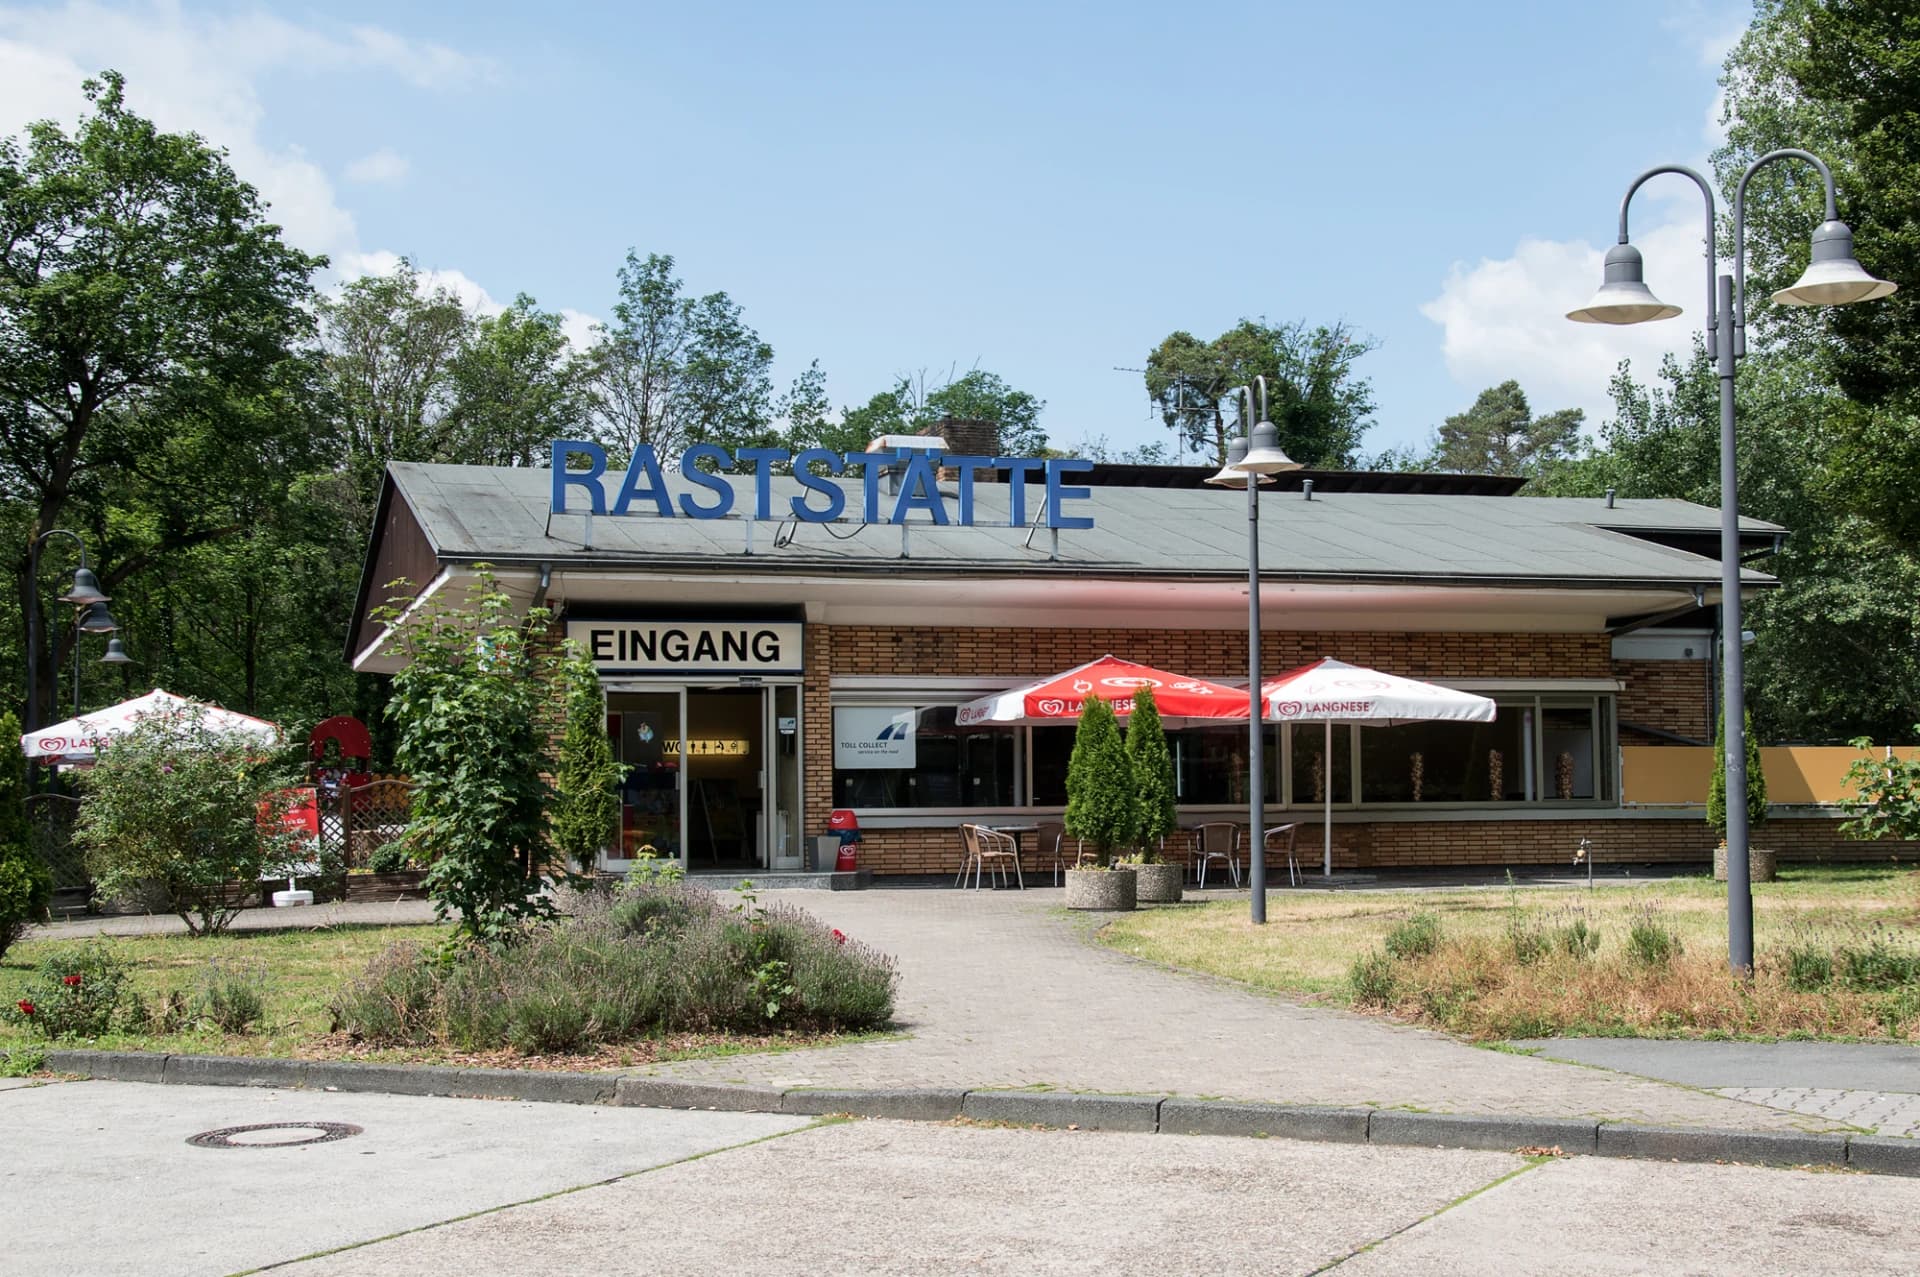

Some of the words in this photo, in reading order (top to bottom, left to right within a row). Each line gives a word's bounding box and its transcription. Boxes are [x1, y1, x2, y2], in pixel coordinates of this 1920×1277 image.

[551, 439, 1094, 530] RASTSTÄTTE
[590, 629, 780, 663] EINGANG
[1068, 698, 1137, 712] LAESE
[71, 736, 109, 747] LANG
